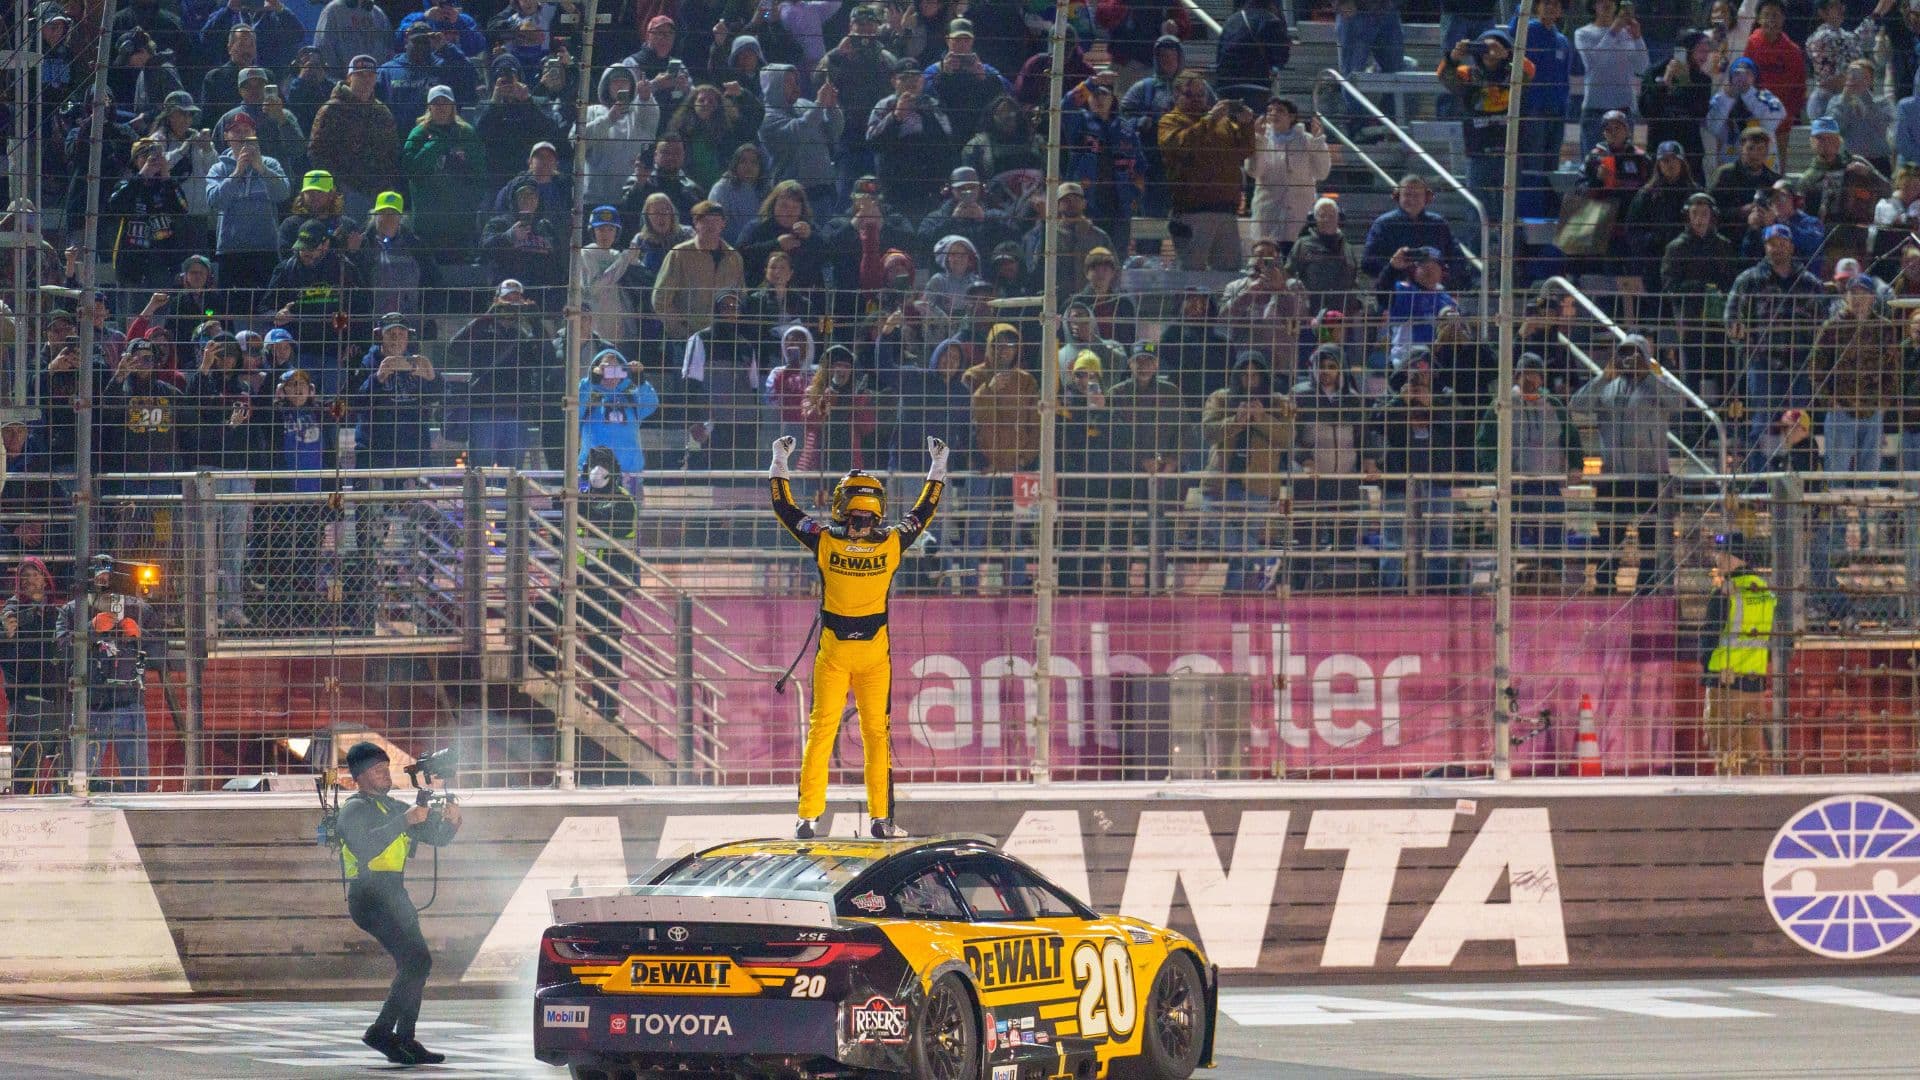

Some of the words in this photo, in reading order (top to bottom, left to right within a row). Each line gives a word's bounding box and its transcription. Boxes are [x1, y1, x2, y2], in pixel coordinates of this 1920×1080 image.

[140, 408, 163, 426] 20
[1021, 481, 1039, 498] 14
[796, 932, 827, 942] XSE
[791, 975, 827, 998] 20
[1073, 941, 1136, 1038] 20
[546, 1011, 574, 1023] Mobil
[631, 1013, 733, 1036] TOYOTA
